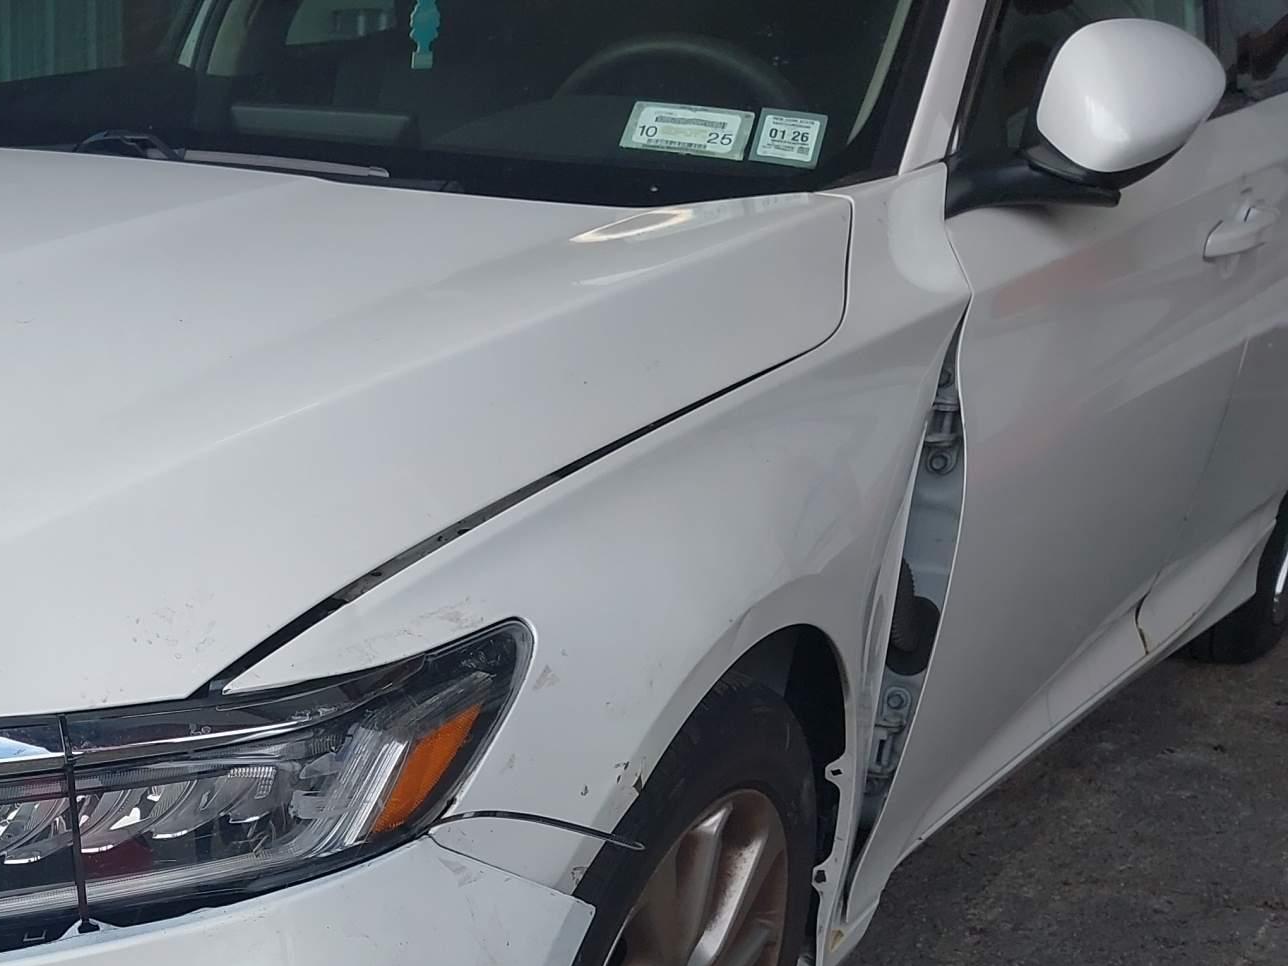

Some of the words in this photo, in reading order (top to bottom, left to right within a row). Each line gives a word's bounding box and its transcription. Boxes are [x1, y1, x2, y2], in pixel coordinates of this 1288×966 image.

[639, 125, 658, 138] 10
[707, 132, 733, 146] 25
[769, 128, 786, 140] 01
[791, 130, 810, 143] 26
